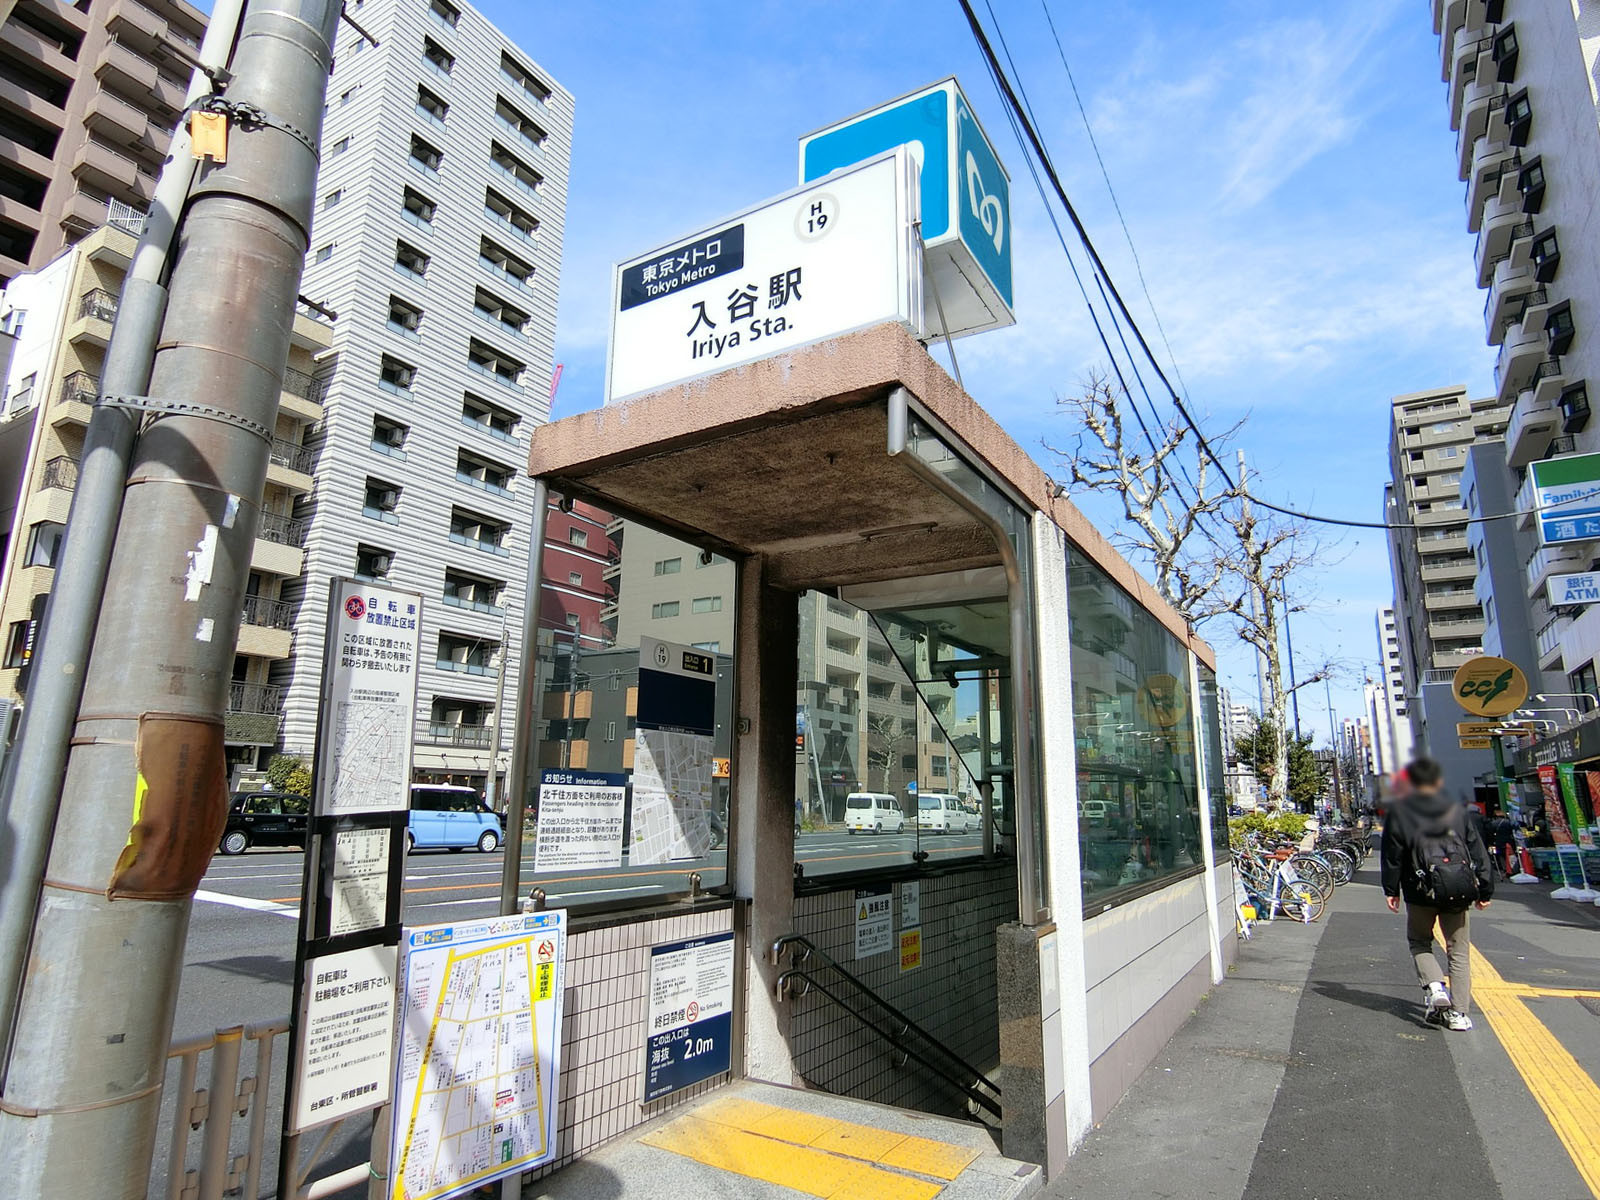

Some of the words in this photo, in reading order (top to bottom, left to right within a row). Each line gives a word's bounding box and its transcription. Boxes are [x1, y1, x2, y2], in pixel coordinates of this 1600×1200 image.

[811, 201, 822, 216] H
[807, 214, 828, 233] 19
[641, 239, 721, 285] 東京メトロ
[646, 278, 678, 297] Tokyo
[681, 263, 716, 286] Metro
[686, 266, 803, 338] 入谷駅
[692, 331, 741, 360] Iriya
[750, 316, 794, 342] Sta.
[1566, 576, 1594, 589] 銀行
[1565, 587, 1599, 601] ATM
[366, 612, 416, 630] 放置禁止区域
[344, 633, 412, 651] この区域に放置された
[342, 645, 412, 662] 自転車は、予告の有無に
[657, 654, 666, 663] 19
[341, 657, 411, 673] 関わらず撤去いたします
[702, 658, 708, 673] 1
[544, 773, 573, 784] お知らせ
[575, 777, 608, 785] Information
[542, 789, 623, 801] 北千住方面をご利用のお客様
[316, 969, 348, 986] 自転車は
[315, 975, 391, 1002] 駐輪場をご利用下さい
[654, 1008, 686, 1029] 終日禁煙
[653, 1027, 690, 1047] この出入口は
[651, 1047, 670, 1065] 海抜
[684, 1037, 714, 1060] 2.0m
[310, 1081, 379, 1112] 台東区・所管警察署
